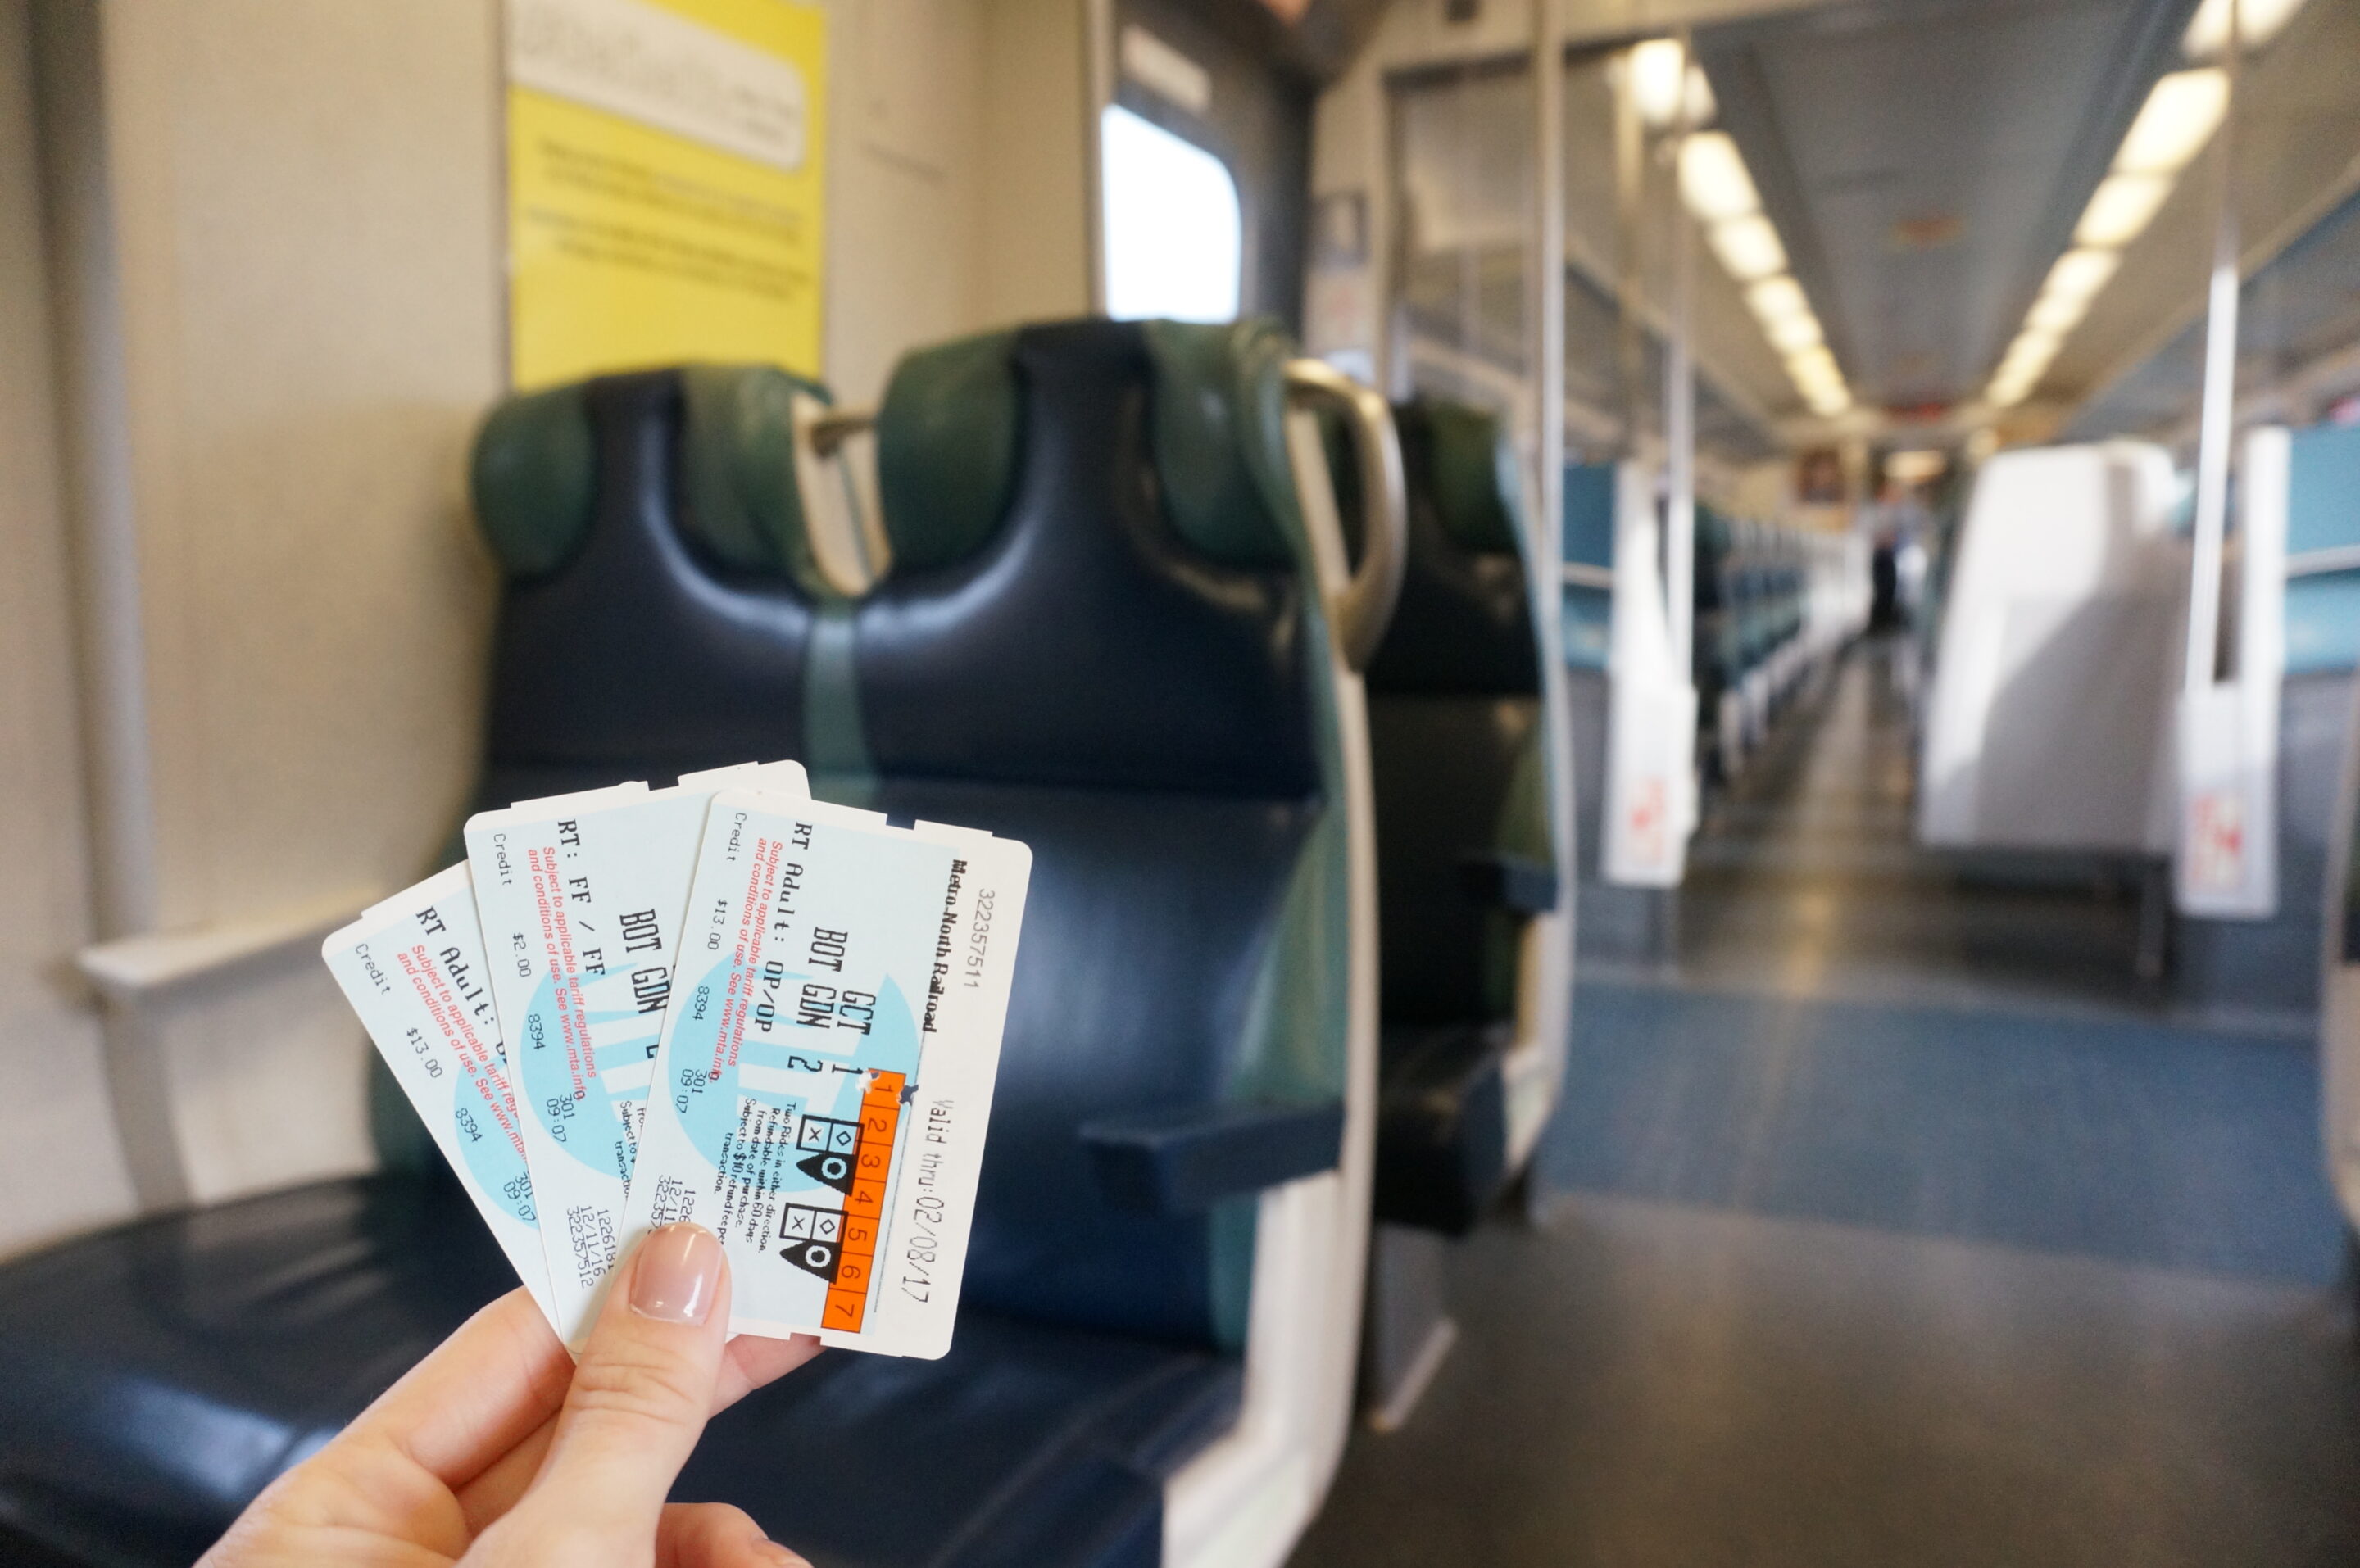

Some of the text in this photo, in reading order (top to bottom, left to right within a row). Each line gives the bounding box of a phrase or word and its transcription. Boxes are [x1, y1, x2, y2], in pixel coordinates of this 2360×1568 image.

[527, 849, 544, 872] and
[755, 837, 767, 862] and
[533, 874, 554, 940] conditions
[557, 818, 606, 976] RT: FF / FF
[692, 812, 747, 1021] Credit $13.00 8394
[741, 863, 762, 927] conditions
[492, 832, 547, 1051] Credit $2.00 8394
[546, 942, 560, 956] of
[738, 928, 750, 944] of
[754, 821, 813, 1033] RT Adult: OP/OP
[963, 888, 996, 988] 322357511
[397, 952, 420, 976] and
[415, 905, 495, 1025] RT Adult:
[542, 846, 597, 1079] Subject to applicable tariff regulations
[549, 958, 562, 985] use.
[619, 908, 672, 1015] BOT GDN
[727, 840, 783, 1067] Subject to applicable tariff regulations
[733, 943, 745, 968] use.
[555, 987, 568, 1011] See
[727, 972, 742, 996] See
[787, 926, 849, 1073] BOT GDN 2
[921, 962, 949, 1033] Railroad
[411, 977, 455, 1037] conditions
[411, 944, 447, 990] Subject
[438, 989, 452, 1004] to
[447, 1004, 489, 1063] applicable
[483, 1063, 511, 1091] tariff
[355, 943, 483, 1143] Credit $13.00 8394
[450, 1038, 467, 1051] of
[831, 990, 877, 1076] GCT 1
[458, 1052, 478, 1078] use.
[691, 1068, 708, 1094] 301
[474, 1077, 494, 1101] See
[559, 1093, 576, 1121] 301
[675, 1068, 695, 1114] 09:07
[545, 1097, 568, 1143] 09:07
[620, 1099, 636, 1141] Subject
[628, 1141, 638, 1155] to
[738, 1098, 757, 1138] Subject
[866, 1117, 888, 1133] 2
[924, 1099, 955, 1144] Valid
[713, 1131, 735, 1195] transaction.
[731, 1152, 748, 1174] $10
[735, 1138, 747, 1151] to
[860, 1153, 882, 1169] 3
[614, 1140, 632, 1201] transactio
[724, 1173, 738, 1210] refund
[734, 1109, 768, 1229] from date of purchase.
[744, 1107, 782, 1244] Refundable within 60 days
[757, 1102, 797, 1254] Two Rides in either direction.
[502, 1181, 538, 1222] 09:07
[663, 1179, 683, 1221] 12/11
[678, 1189, 697, 1224] 1226
[720, 1209, 733, 1226] fee
[854, 1190, 874, 1205] 4
[566, 1205, 595, 1289] 322357512
[579, 1205, 607, 1278] 12/11/16
[846, 1226, 869, 1243] 5
[901, 1195, 946, 1304] 02/08/17
[840, 1264, 862, 1280] 6
[834, 1303, 856, 1319] 7
